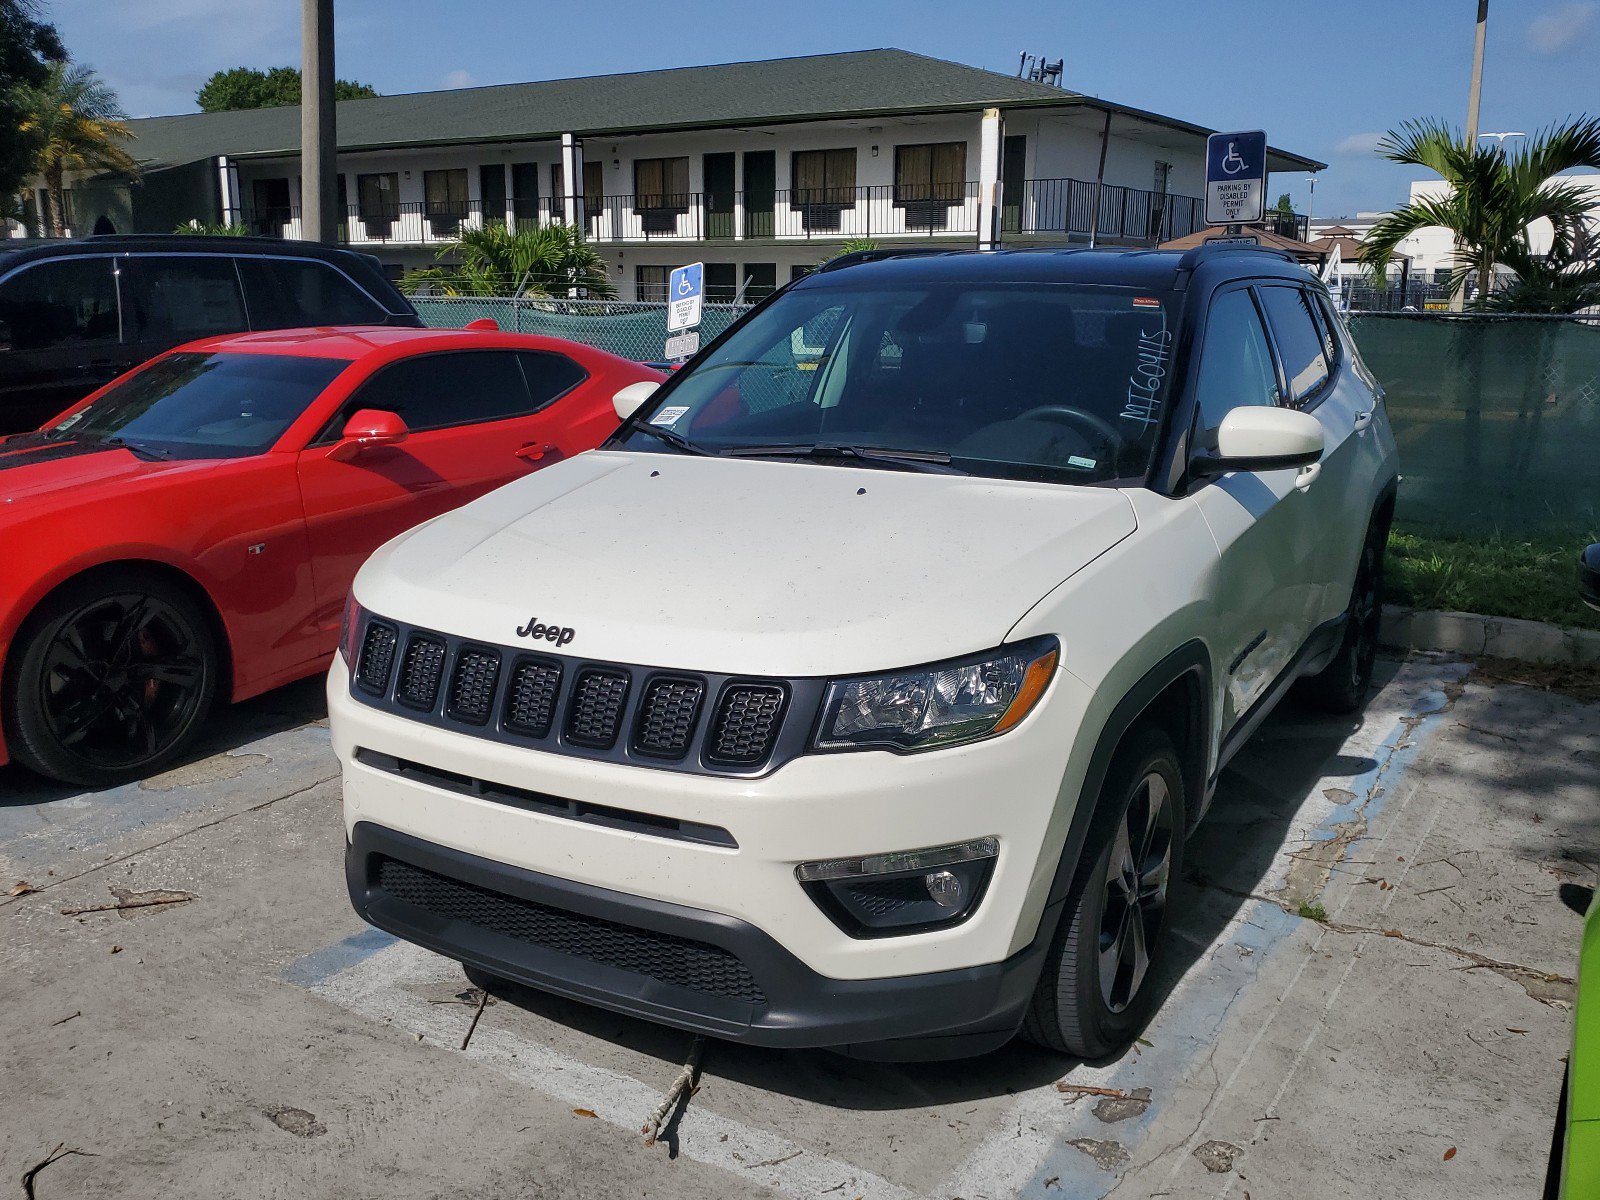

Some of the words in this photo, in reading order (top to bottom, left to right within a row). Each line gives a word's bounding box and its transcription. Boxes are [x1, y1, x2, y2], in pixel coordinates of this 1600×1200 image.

[1217, 183, 1242, 191] PARKING
[1219, 192, 1248, 200] DISABLED
[1225, 208, 1241, 216] ONLY
[516, 617, 576, 648] Jeep
